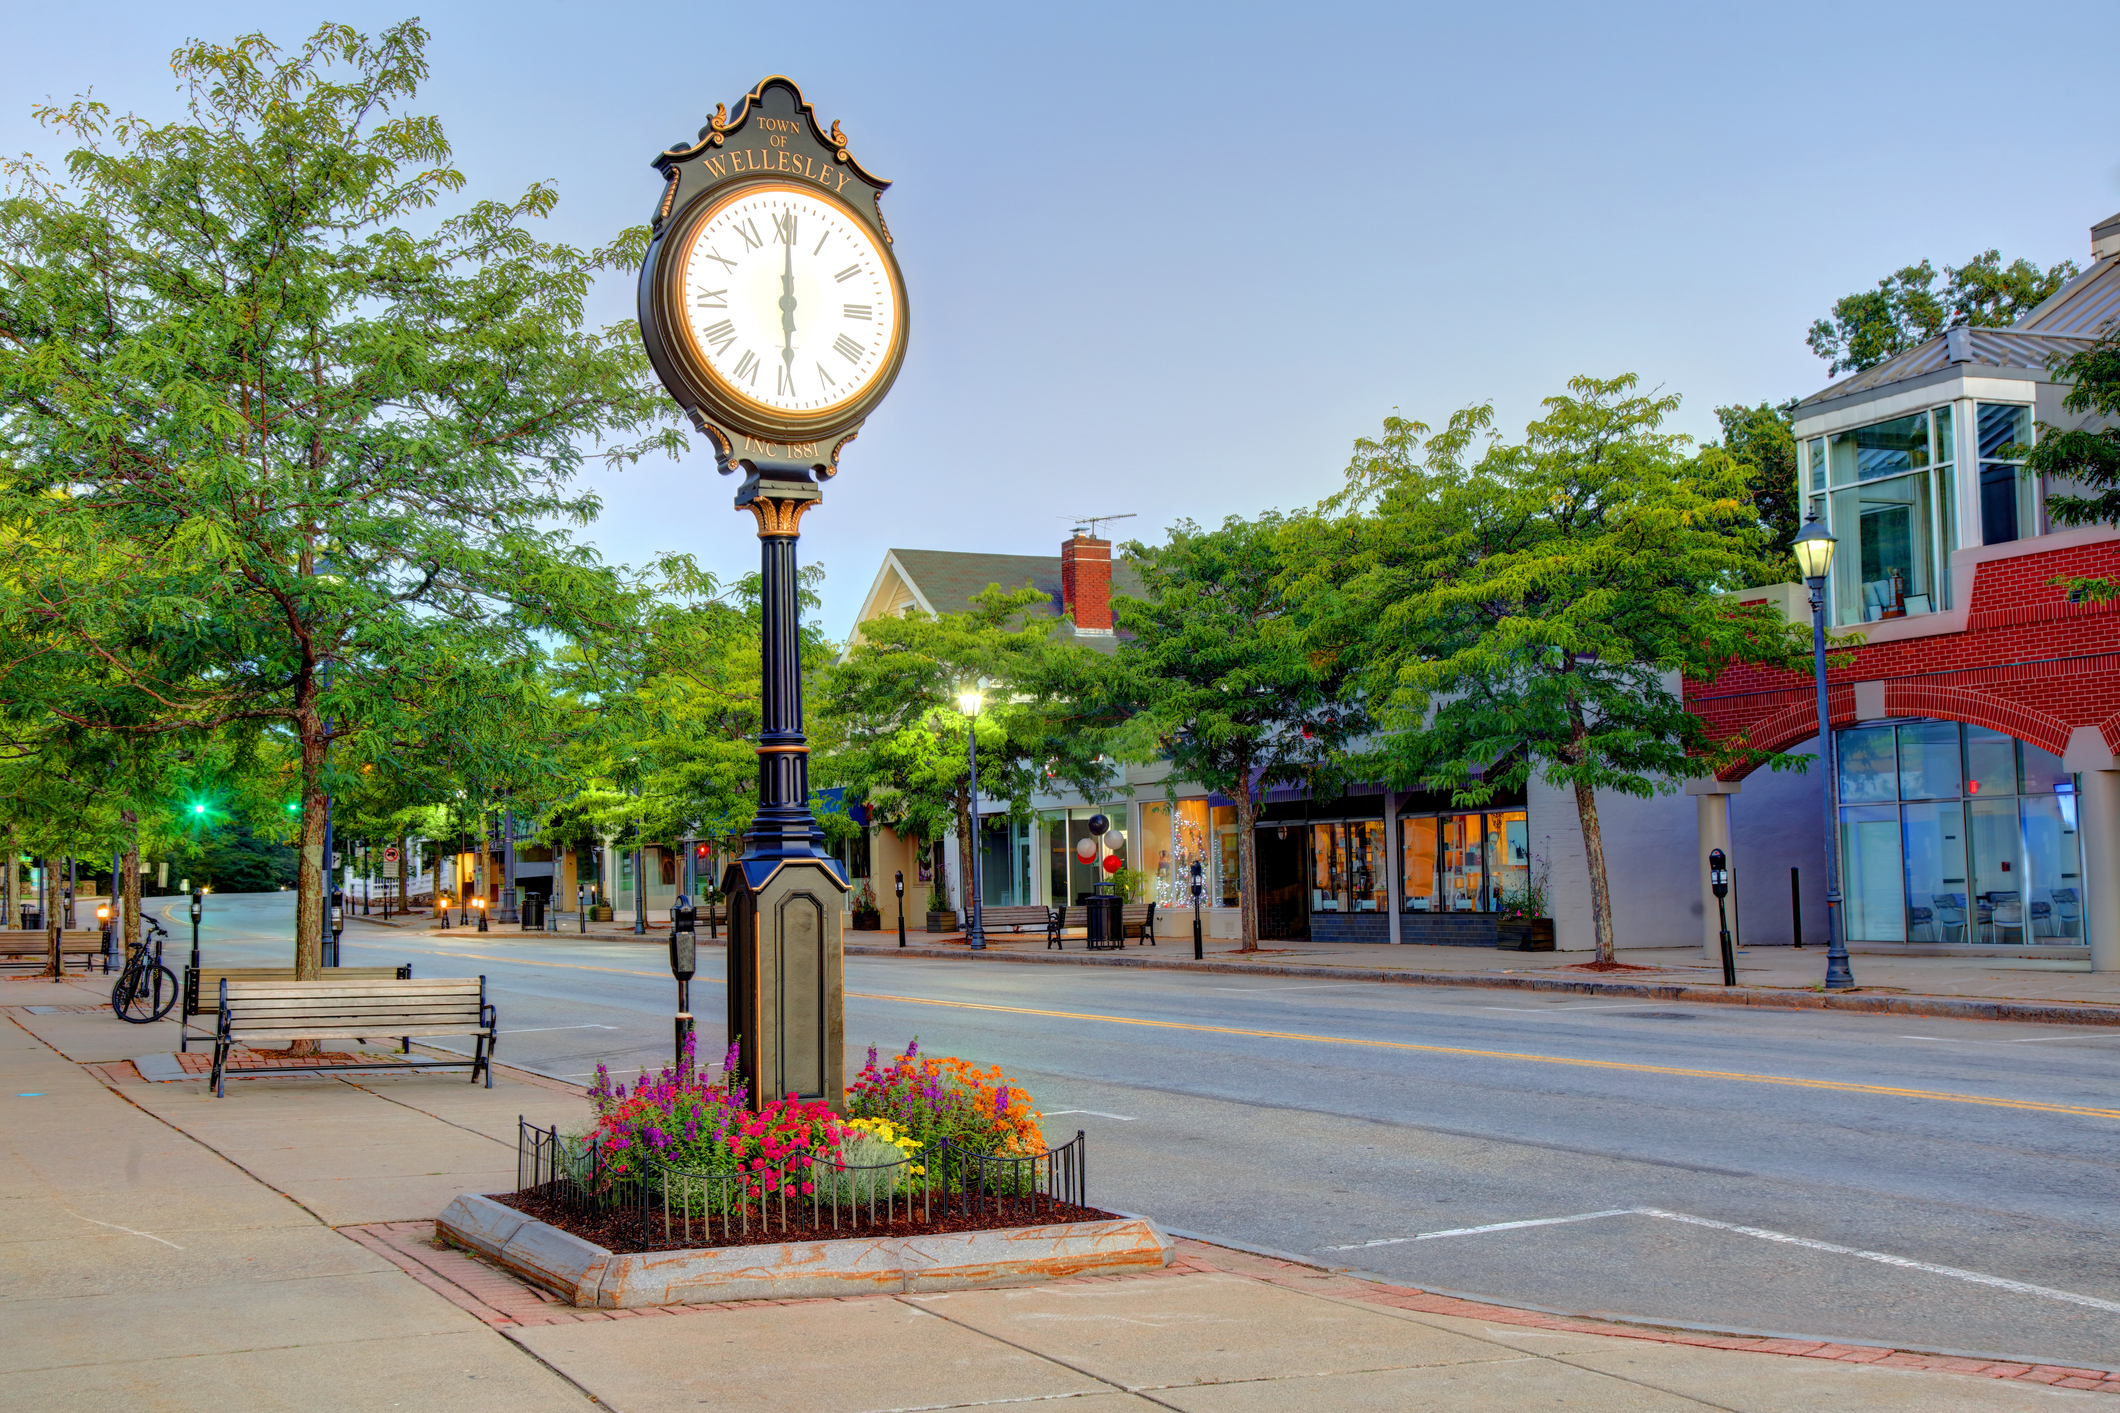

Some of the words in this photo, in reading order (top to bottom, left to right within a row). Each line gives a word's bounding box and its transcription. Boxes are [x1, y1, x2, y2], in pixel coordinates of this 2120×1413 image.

[757, 117, 800, 135] TOWN
[770, 135, 788, 148] OF
[703, 149, 851, 194] WELLESLEY
[733, 217, 764, 254] XI
[706, 246, 738, 275] X
[834, 263, 862, 283] II
[697, 285, 728, 309] IX
[843, 304, 872, 320] III
[702, 318, 738, 357] VIII
[832, 333, 866, 365] IIII
[733, 349, 761, 387] VII
[816, 361, 836, 391] V
[744, 436, 777, 457] INC
[786, 442, 819, 459] 1881
